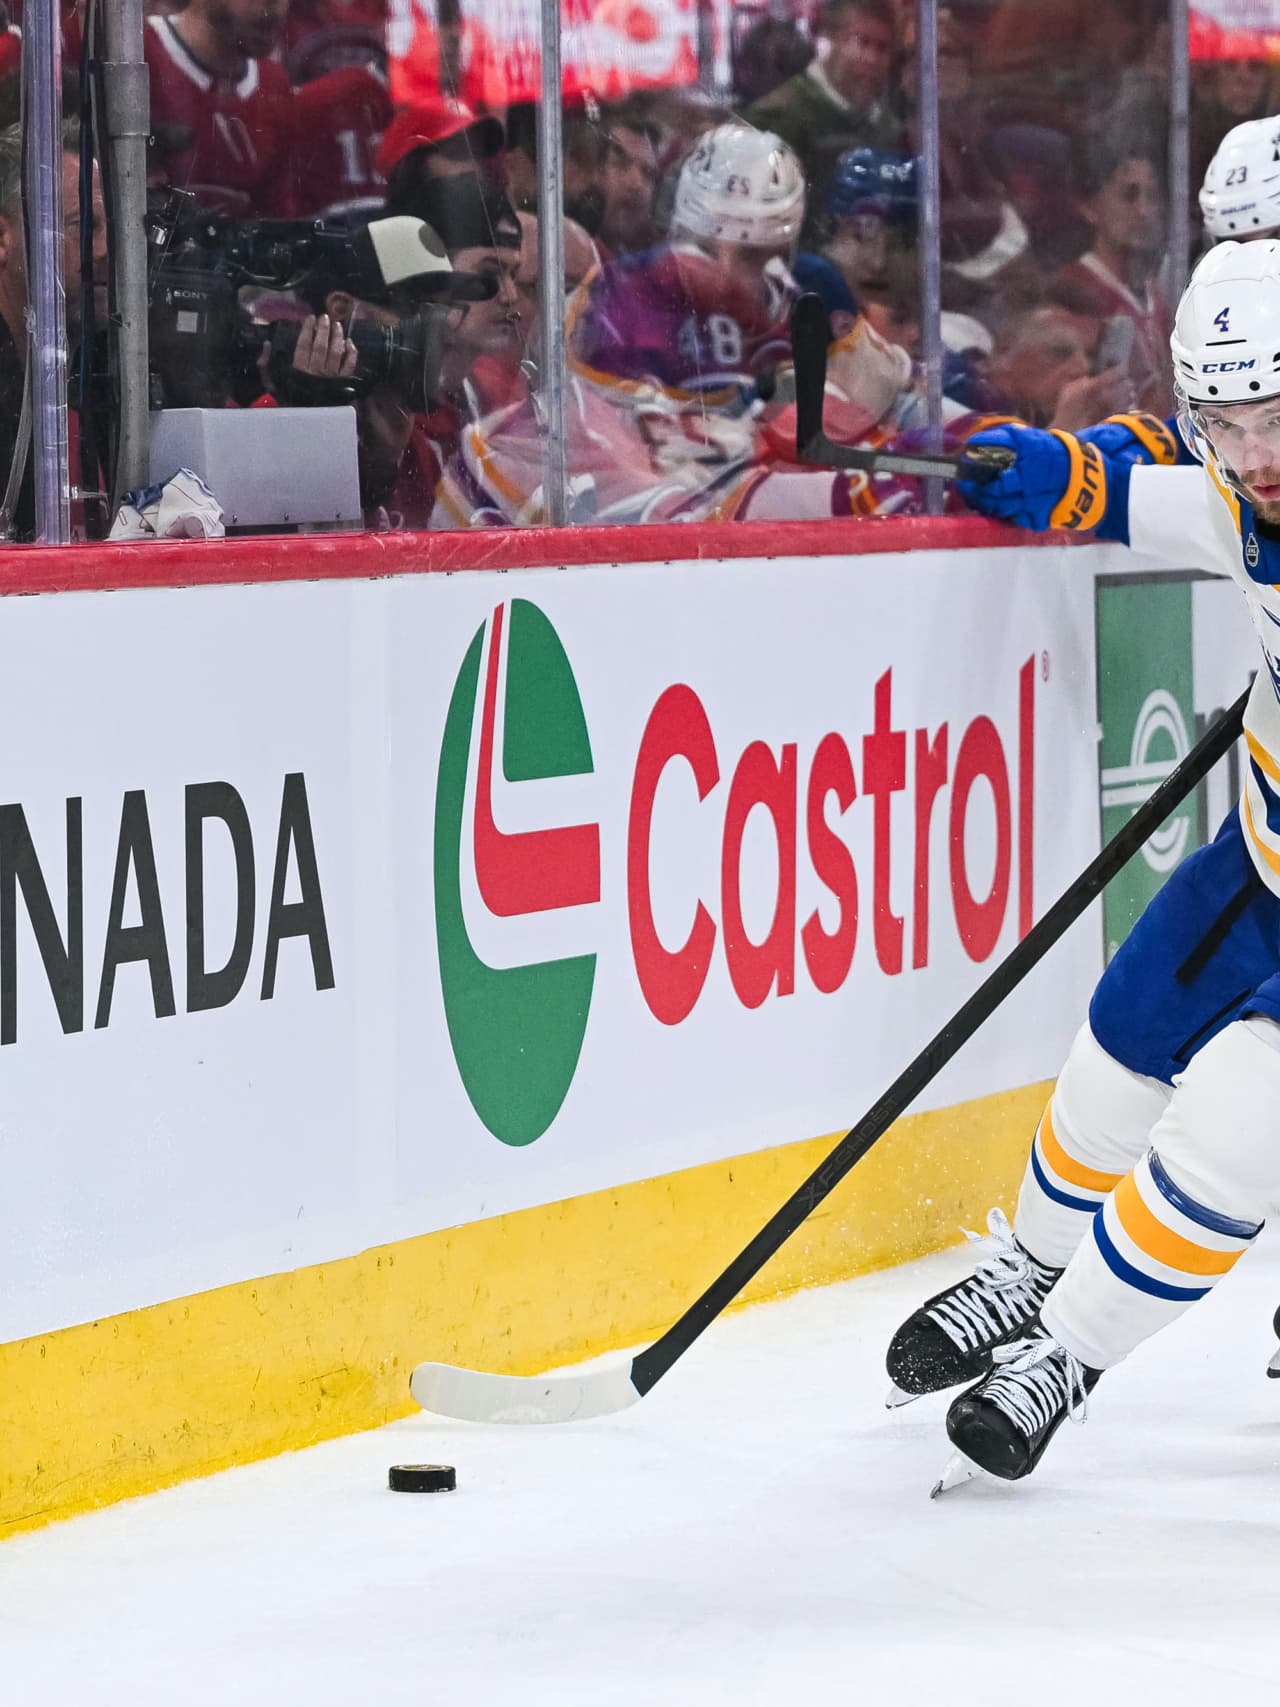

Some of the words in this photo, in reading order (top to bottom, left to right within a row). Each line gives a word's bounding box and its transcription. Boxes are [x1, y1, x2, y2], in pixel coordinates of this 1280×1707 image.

[1226, 166, 1247, 186] 23
[1214, 307, 1230, 332] 4
[1201, 359, 1257, 374] CCM
[627, 653, 1035, 1026] Castrol
[0, 772, 336, 1045] NADA
